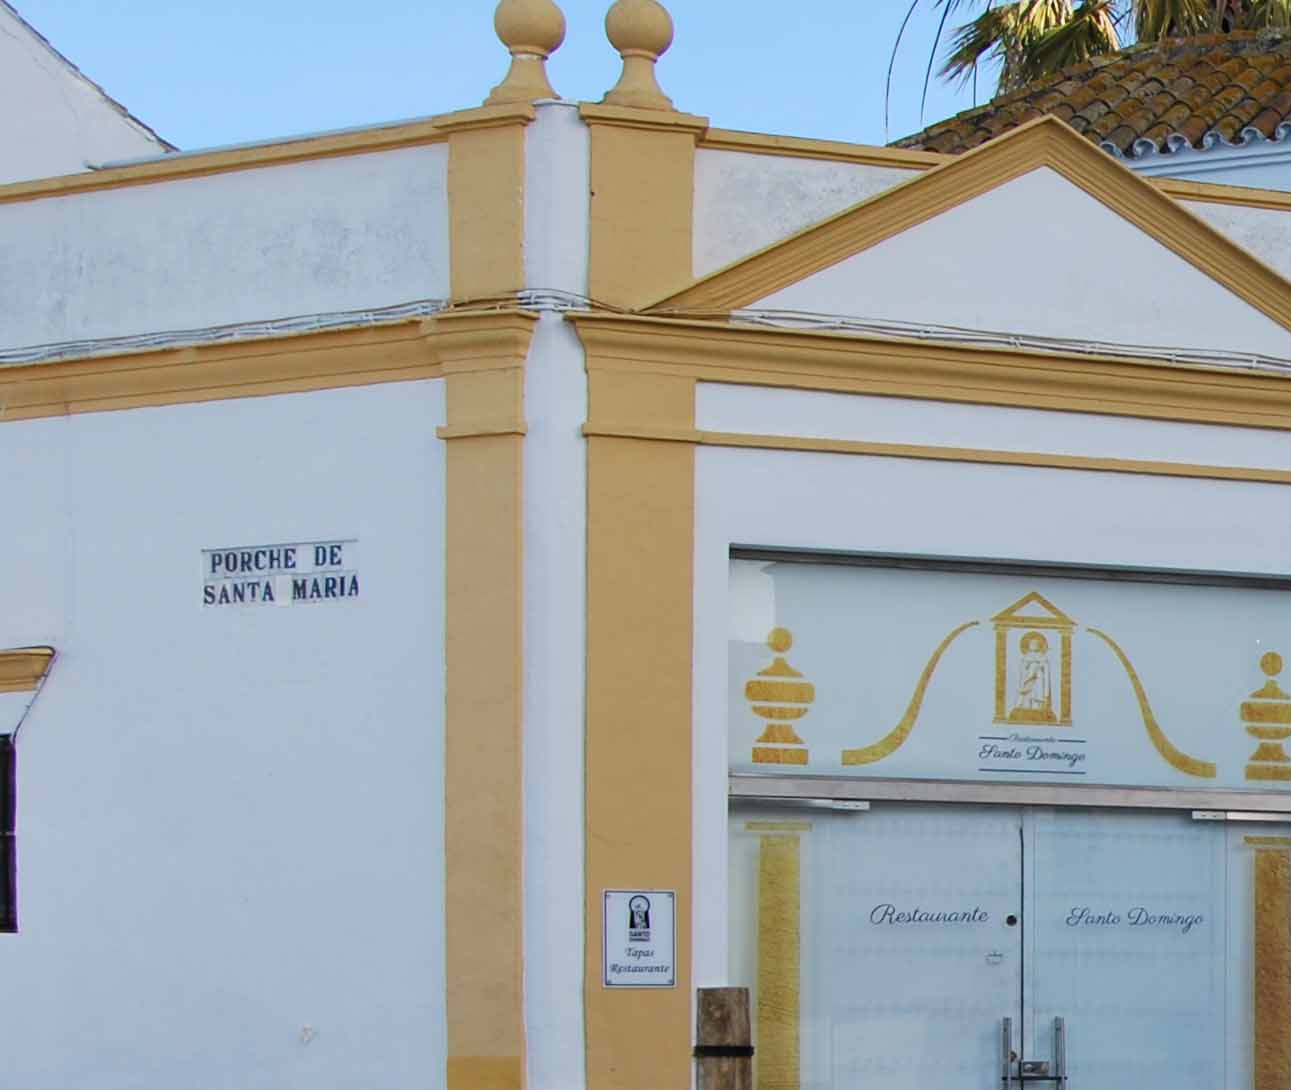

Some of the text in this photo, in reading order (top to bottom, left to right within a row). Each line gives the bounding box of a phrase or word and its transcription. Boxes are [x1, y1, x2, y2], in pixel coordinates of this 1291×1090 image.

[211, 544, 342, 574] PORCHE DE
[203, 573, 360, 605] SANTA MARIA
[978, 744, 1086, 768] Santo Domingo
[870, 904, 1205, 934] Restaurante Santo Domingo
[626, 947, 655, 960] Tapas
[610, 963, 671, 974] Restaurante
